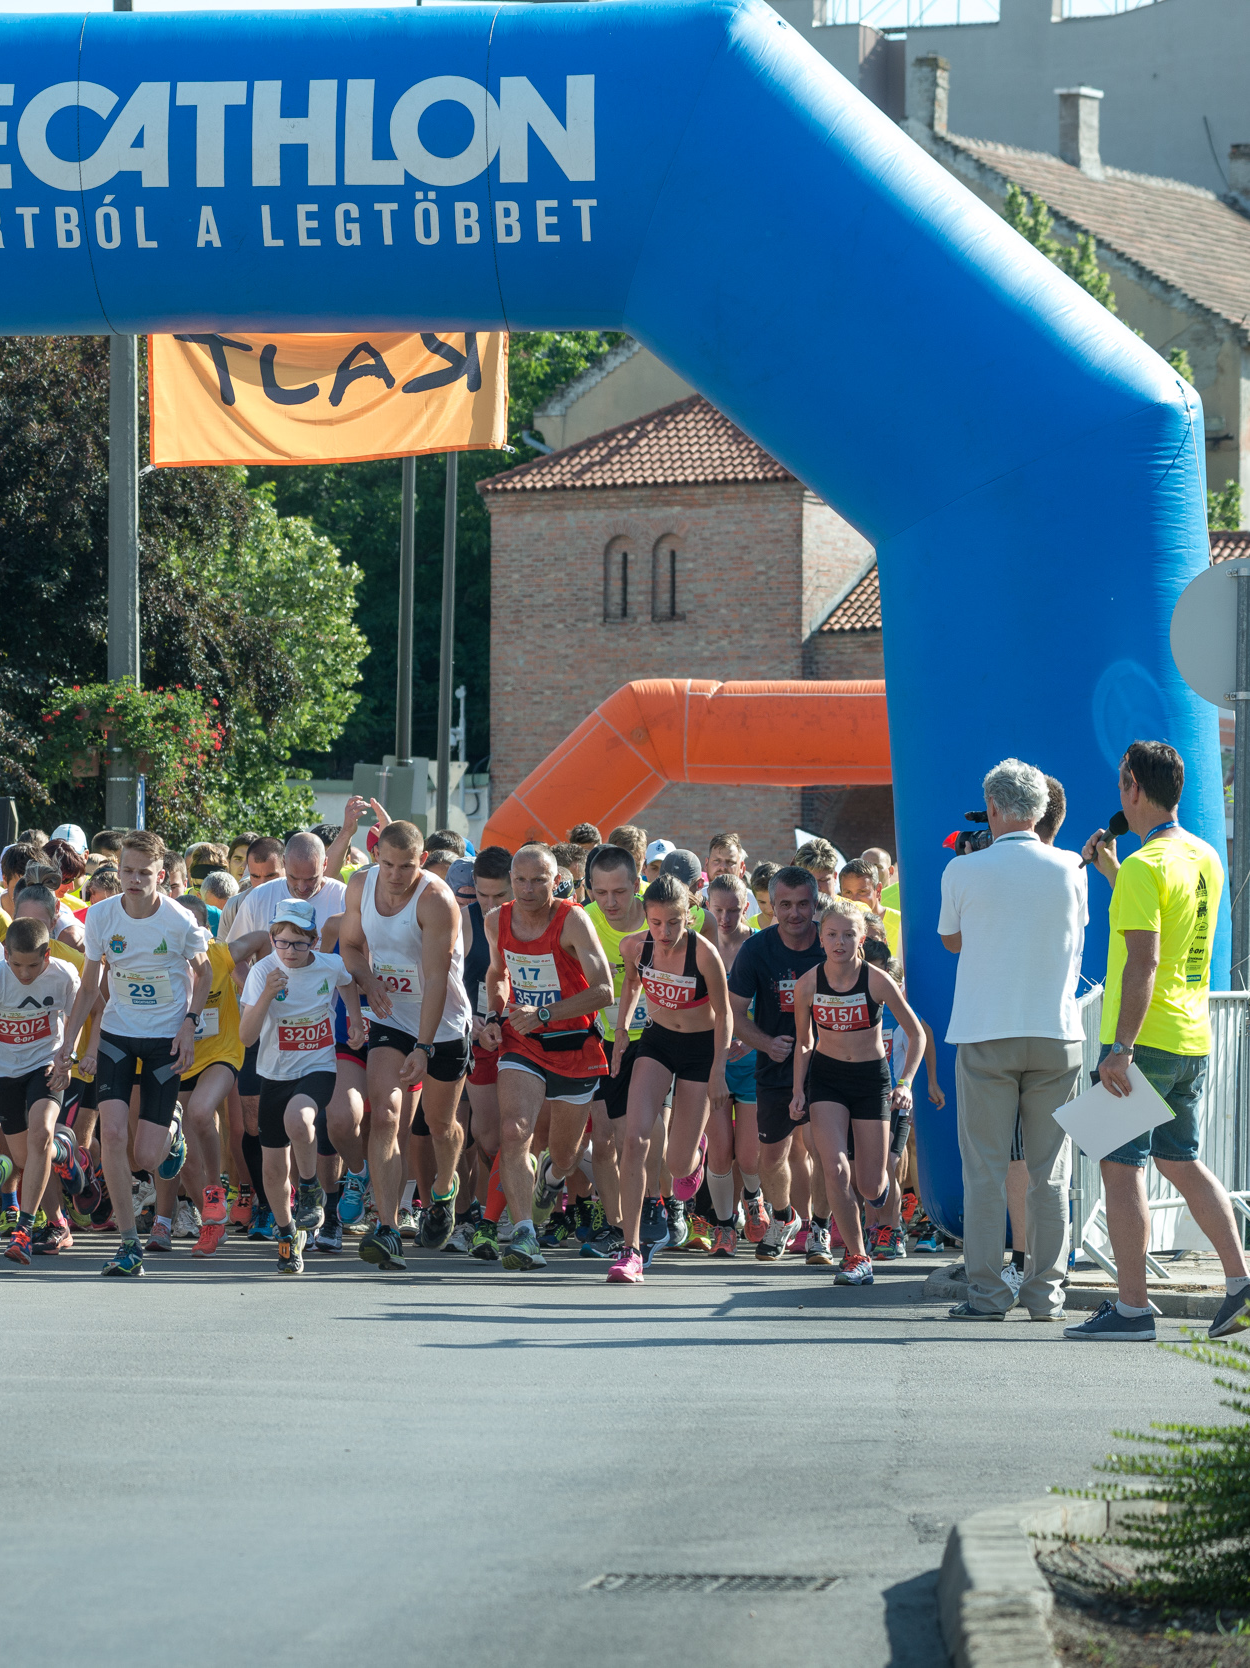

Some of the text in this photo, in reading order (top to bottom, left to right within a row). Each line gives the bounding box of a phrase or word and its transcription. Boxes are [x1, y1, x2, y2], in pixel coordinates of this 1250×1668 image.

[197, 203, 222, 248] A
[263, 191, 597, 247] LEGTÖBBET
[518, 966, 540, 980] 17
[128, 983, 156, 997] 29
[515, 989, 556, 1007] 357/1
[646, 981, 689, 1002] 330/1
[817, 1006, 863, 1022] 315/1
[0, 1018, 46, 1035] 320/2
[284, 1022, 328, 1041] 320/3
